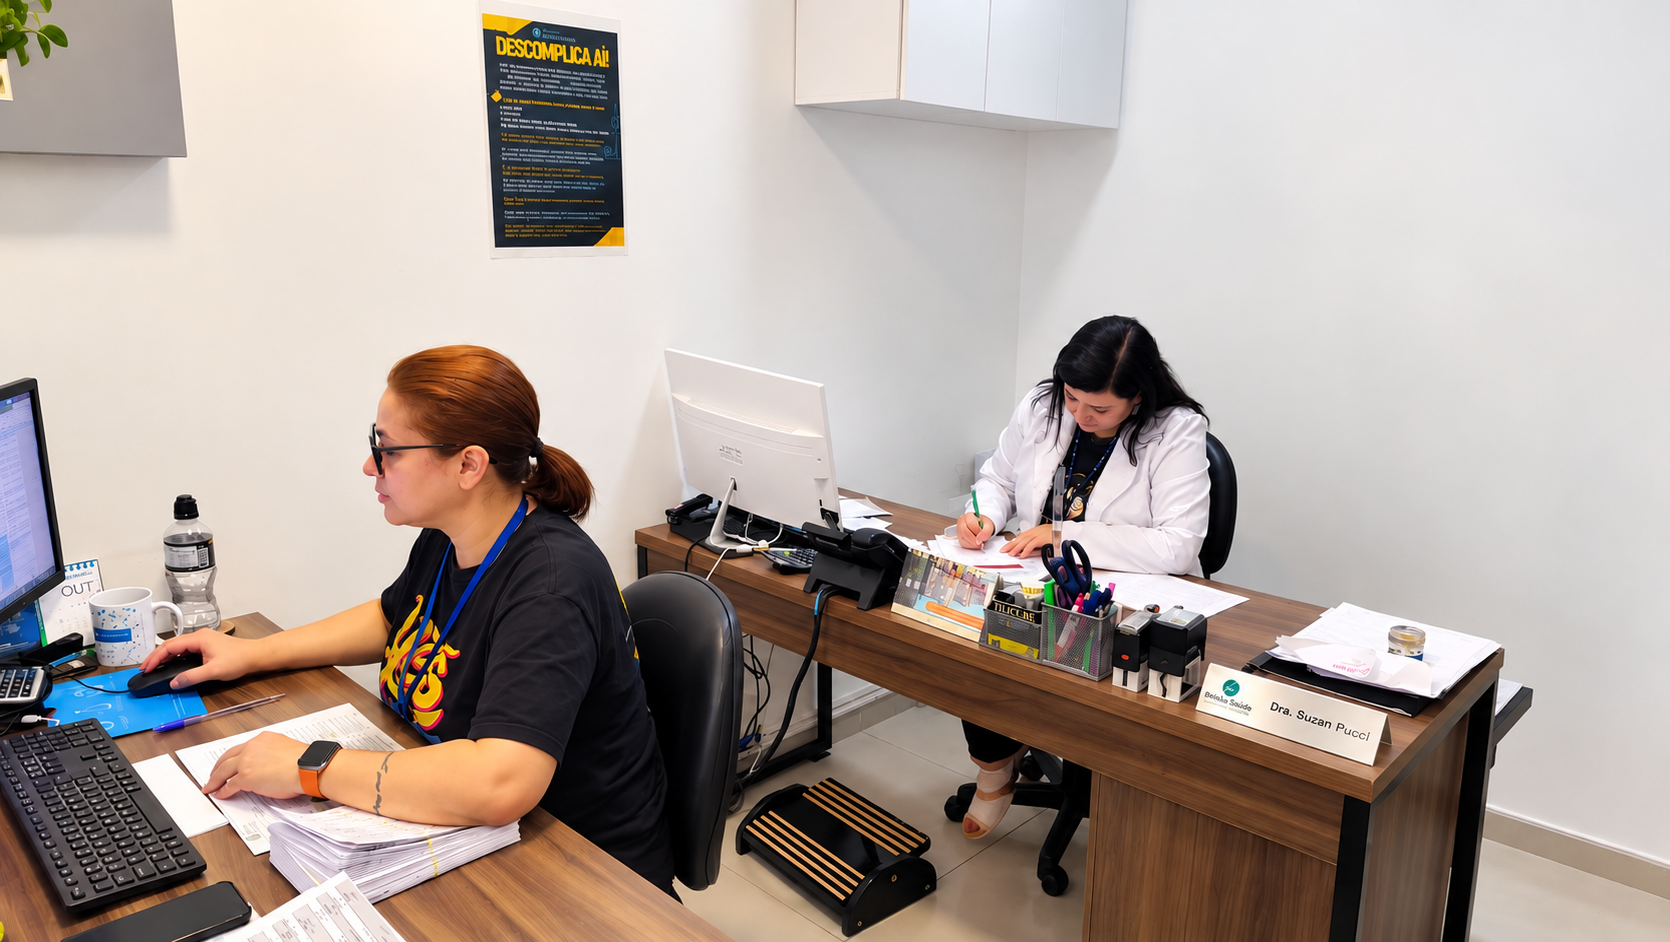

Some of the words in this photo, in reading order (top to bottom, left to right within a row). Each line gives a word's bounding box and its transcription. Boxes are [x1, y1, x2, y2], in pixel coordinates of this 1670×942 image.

[495, 35, 592, 66] DESCOMPLICA
[61, 580, 94, 597] OUT
[1270, 701, 1292, 717] Dra.
[1296, 709, 1332, 729] Suzan
[1335, 722, 1371, 742] Pucci
